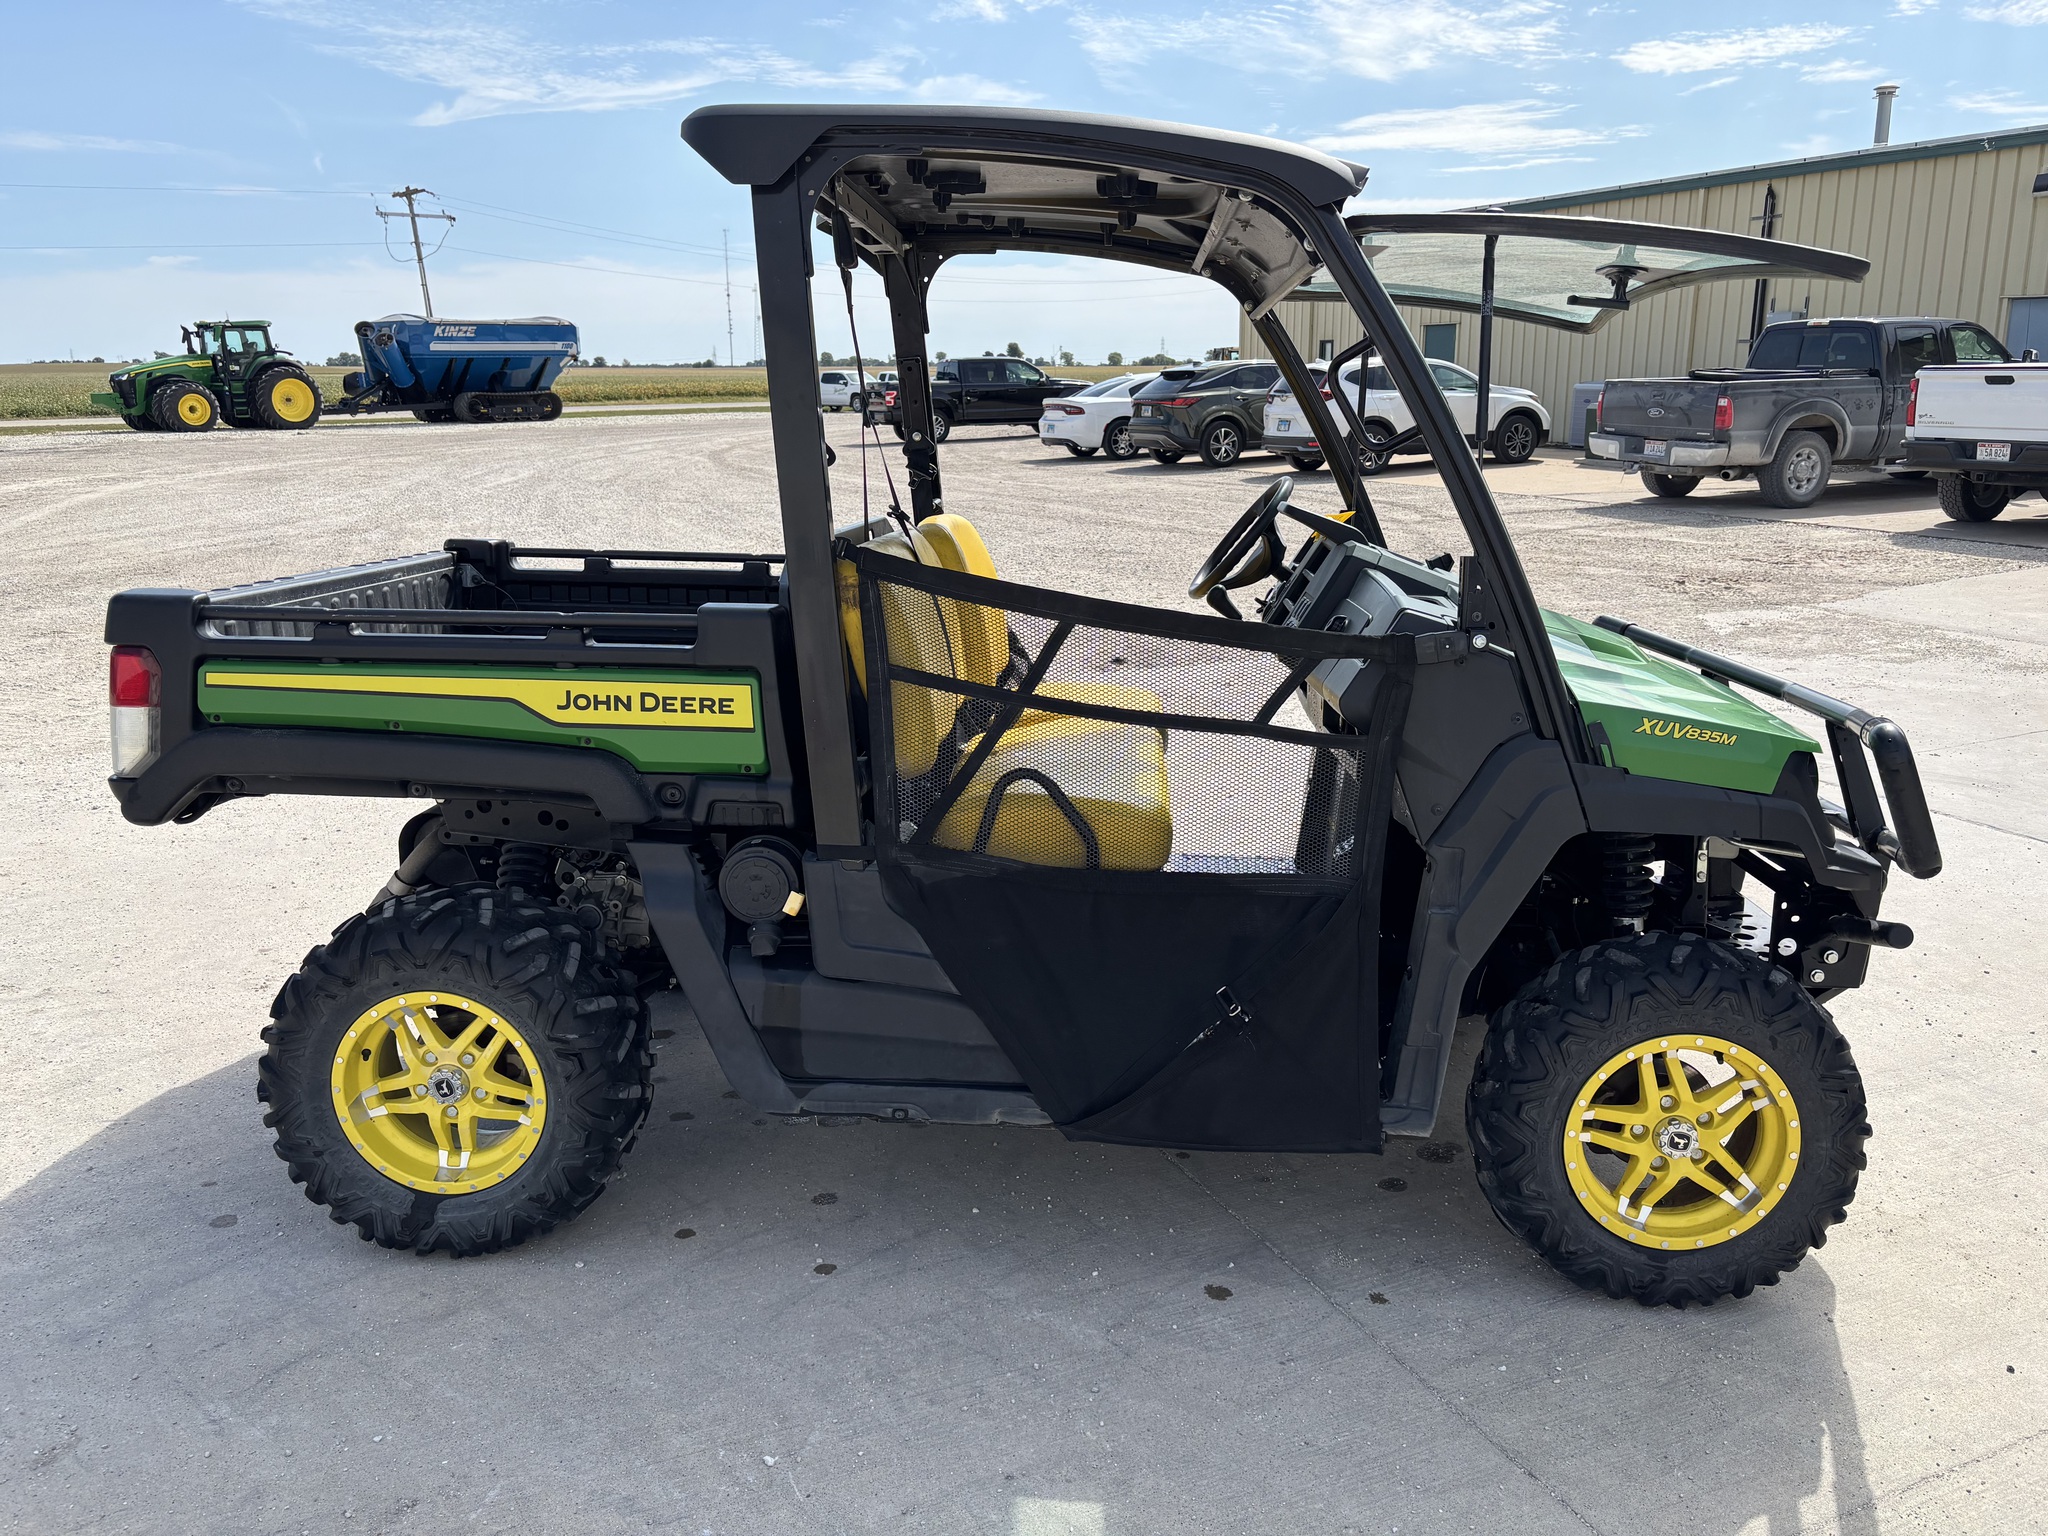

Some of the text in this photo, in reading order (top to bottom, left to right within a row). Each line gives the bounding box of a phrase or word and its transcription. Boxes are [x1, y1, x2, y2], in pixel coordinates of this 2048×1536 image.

[434, 325, 477, 337] KINZE
[557, 690, 735, 715] JOHN DEERE
[1632, 717, 1738, 746] XUV835M
